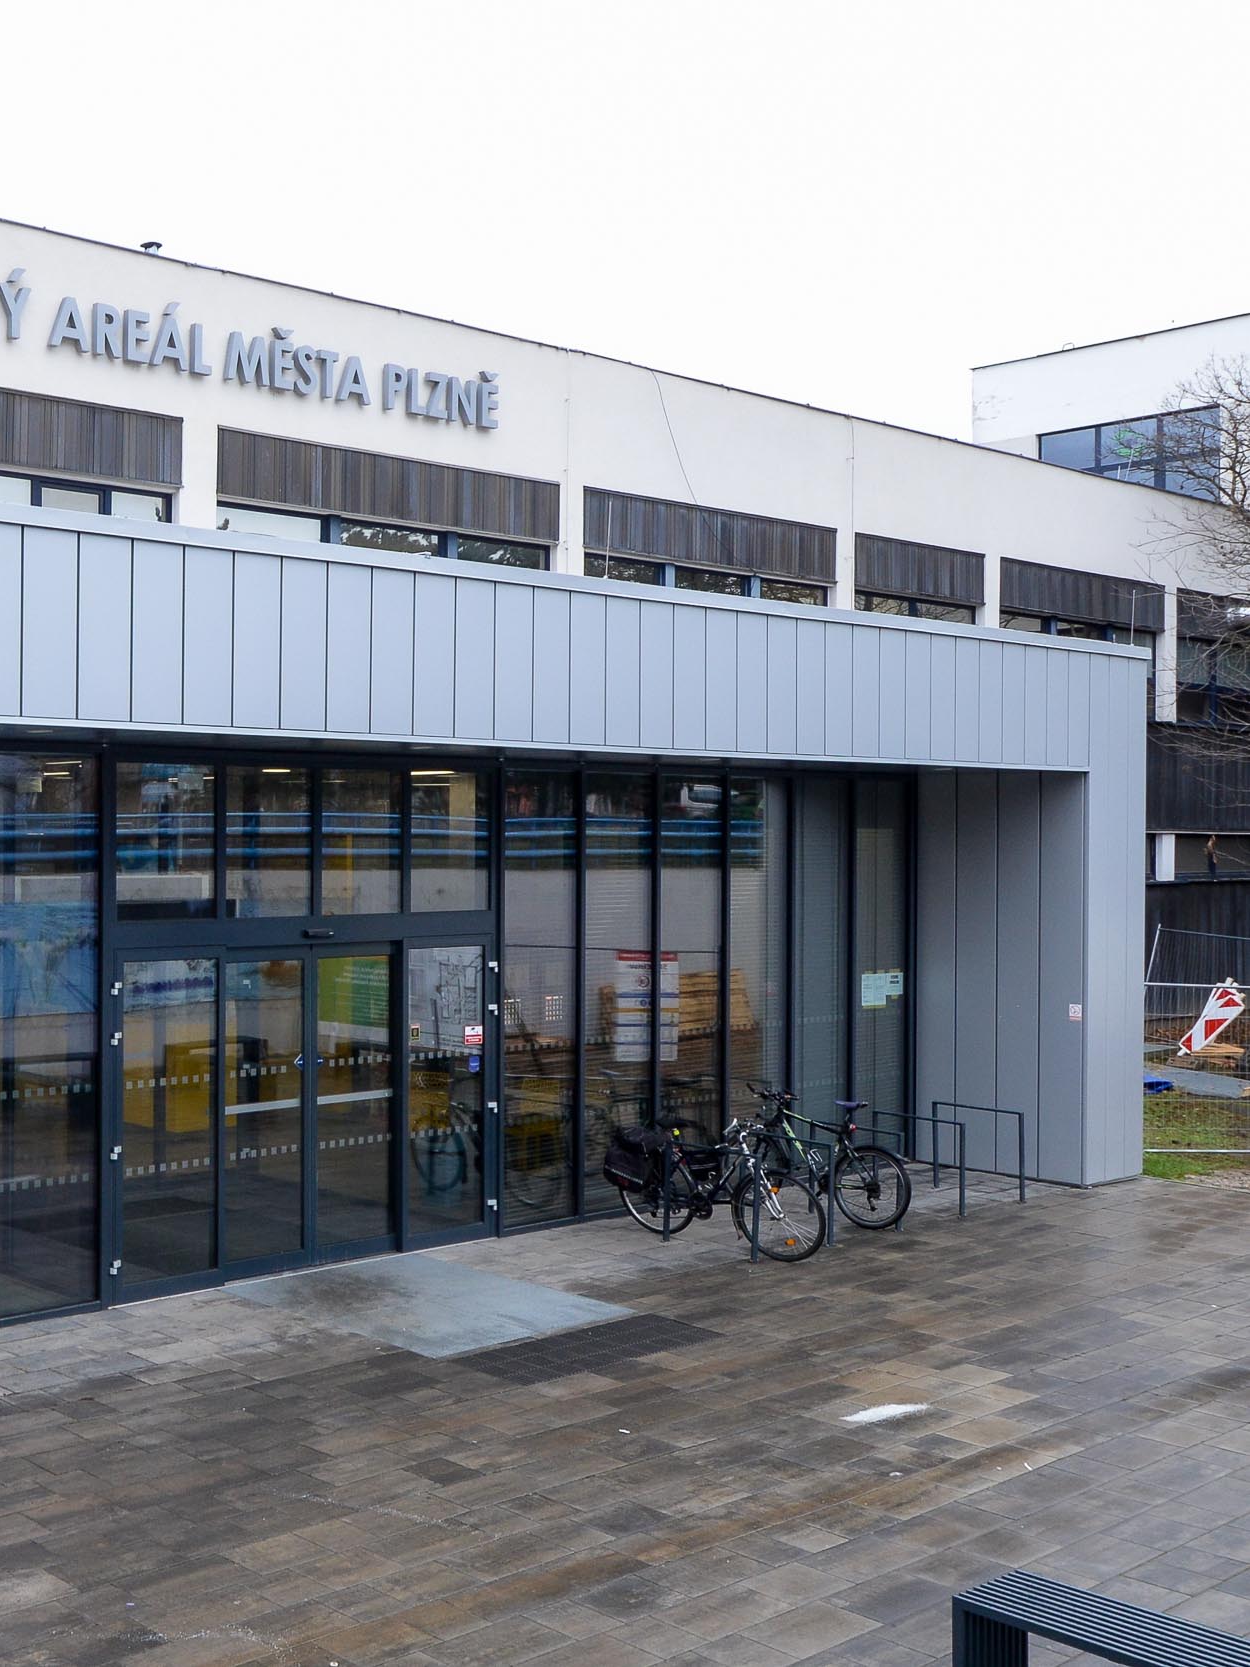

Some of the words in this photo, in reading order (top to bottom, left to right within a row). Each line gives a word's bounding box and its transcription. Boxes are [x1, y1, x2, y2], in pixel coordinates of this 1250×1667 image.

[49, 297, 213, 376] AREÁL
[224, 326, 371, 406] MĚSTA
[383, 363, 500, 430] PLZNĚ
